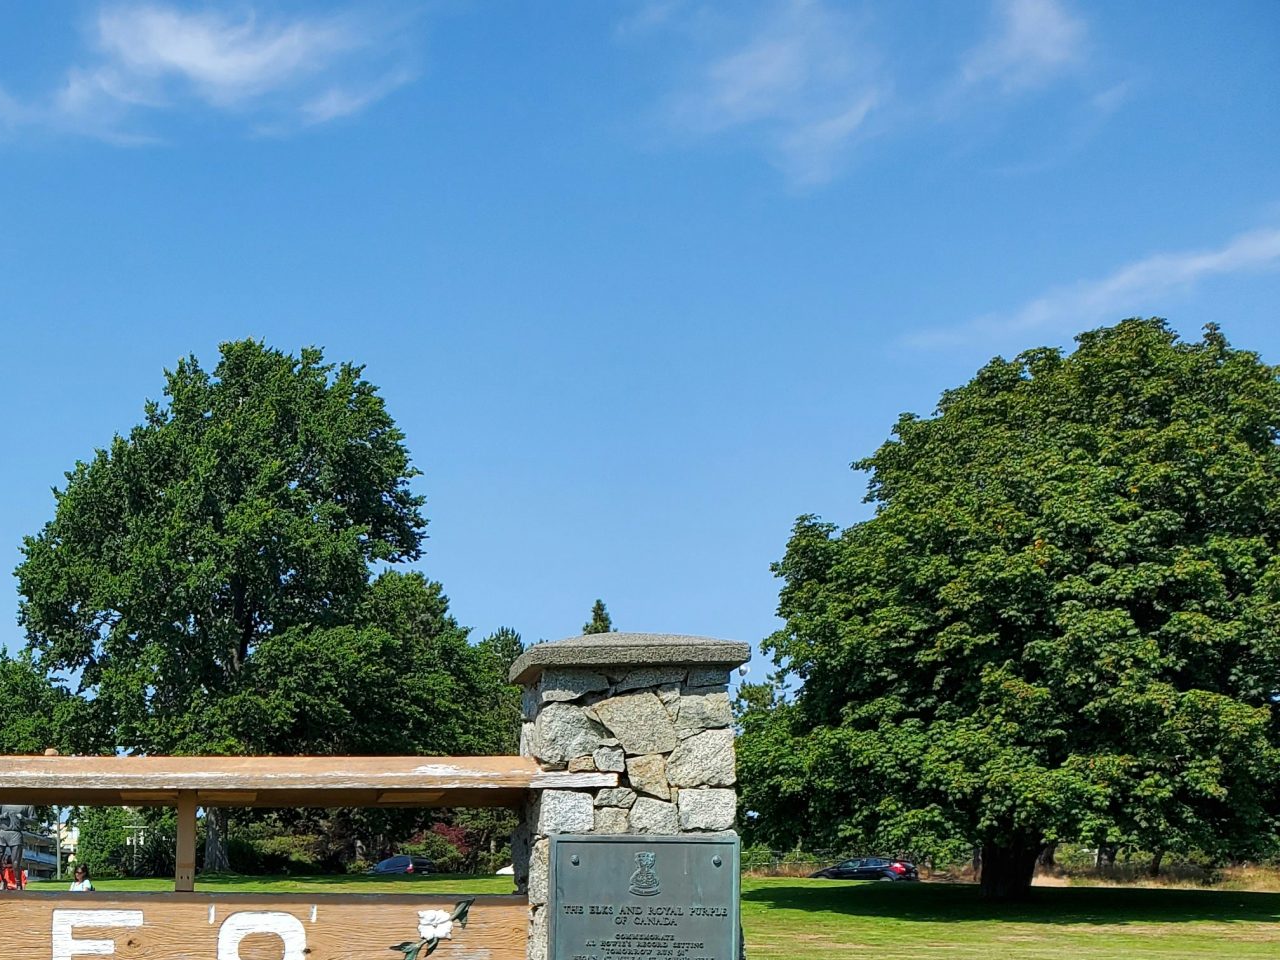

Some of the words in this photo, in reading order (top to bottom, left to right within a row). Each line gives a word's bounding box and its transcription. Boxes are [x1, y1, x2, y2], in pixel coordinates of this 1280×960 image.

[564, 906, 583, 914] THE
[590, 906, 613, 915] ELKS
[619, 906, 643, 915] AND
[648, 906, 684, 916] ROYAL
[689, 907, 728, 917] PURPLE
[615, 917, 628, 925] OF
[634, 917, 677, 926] CANADA
